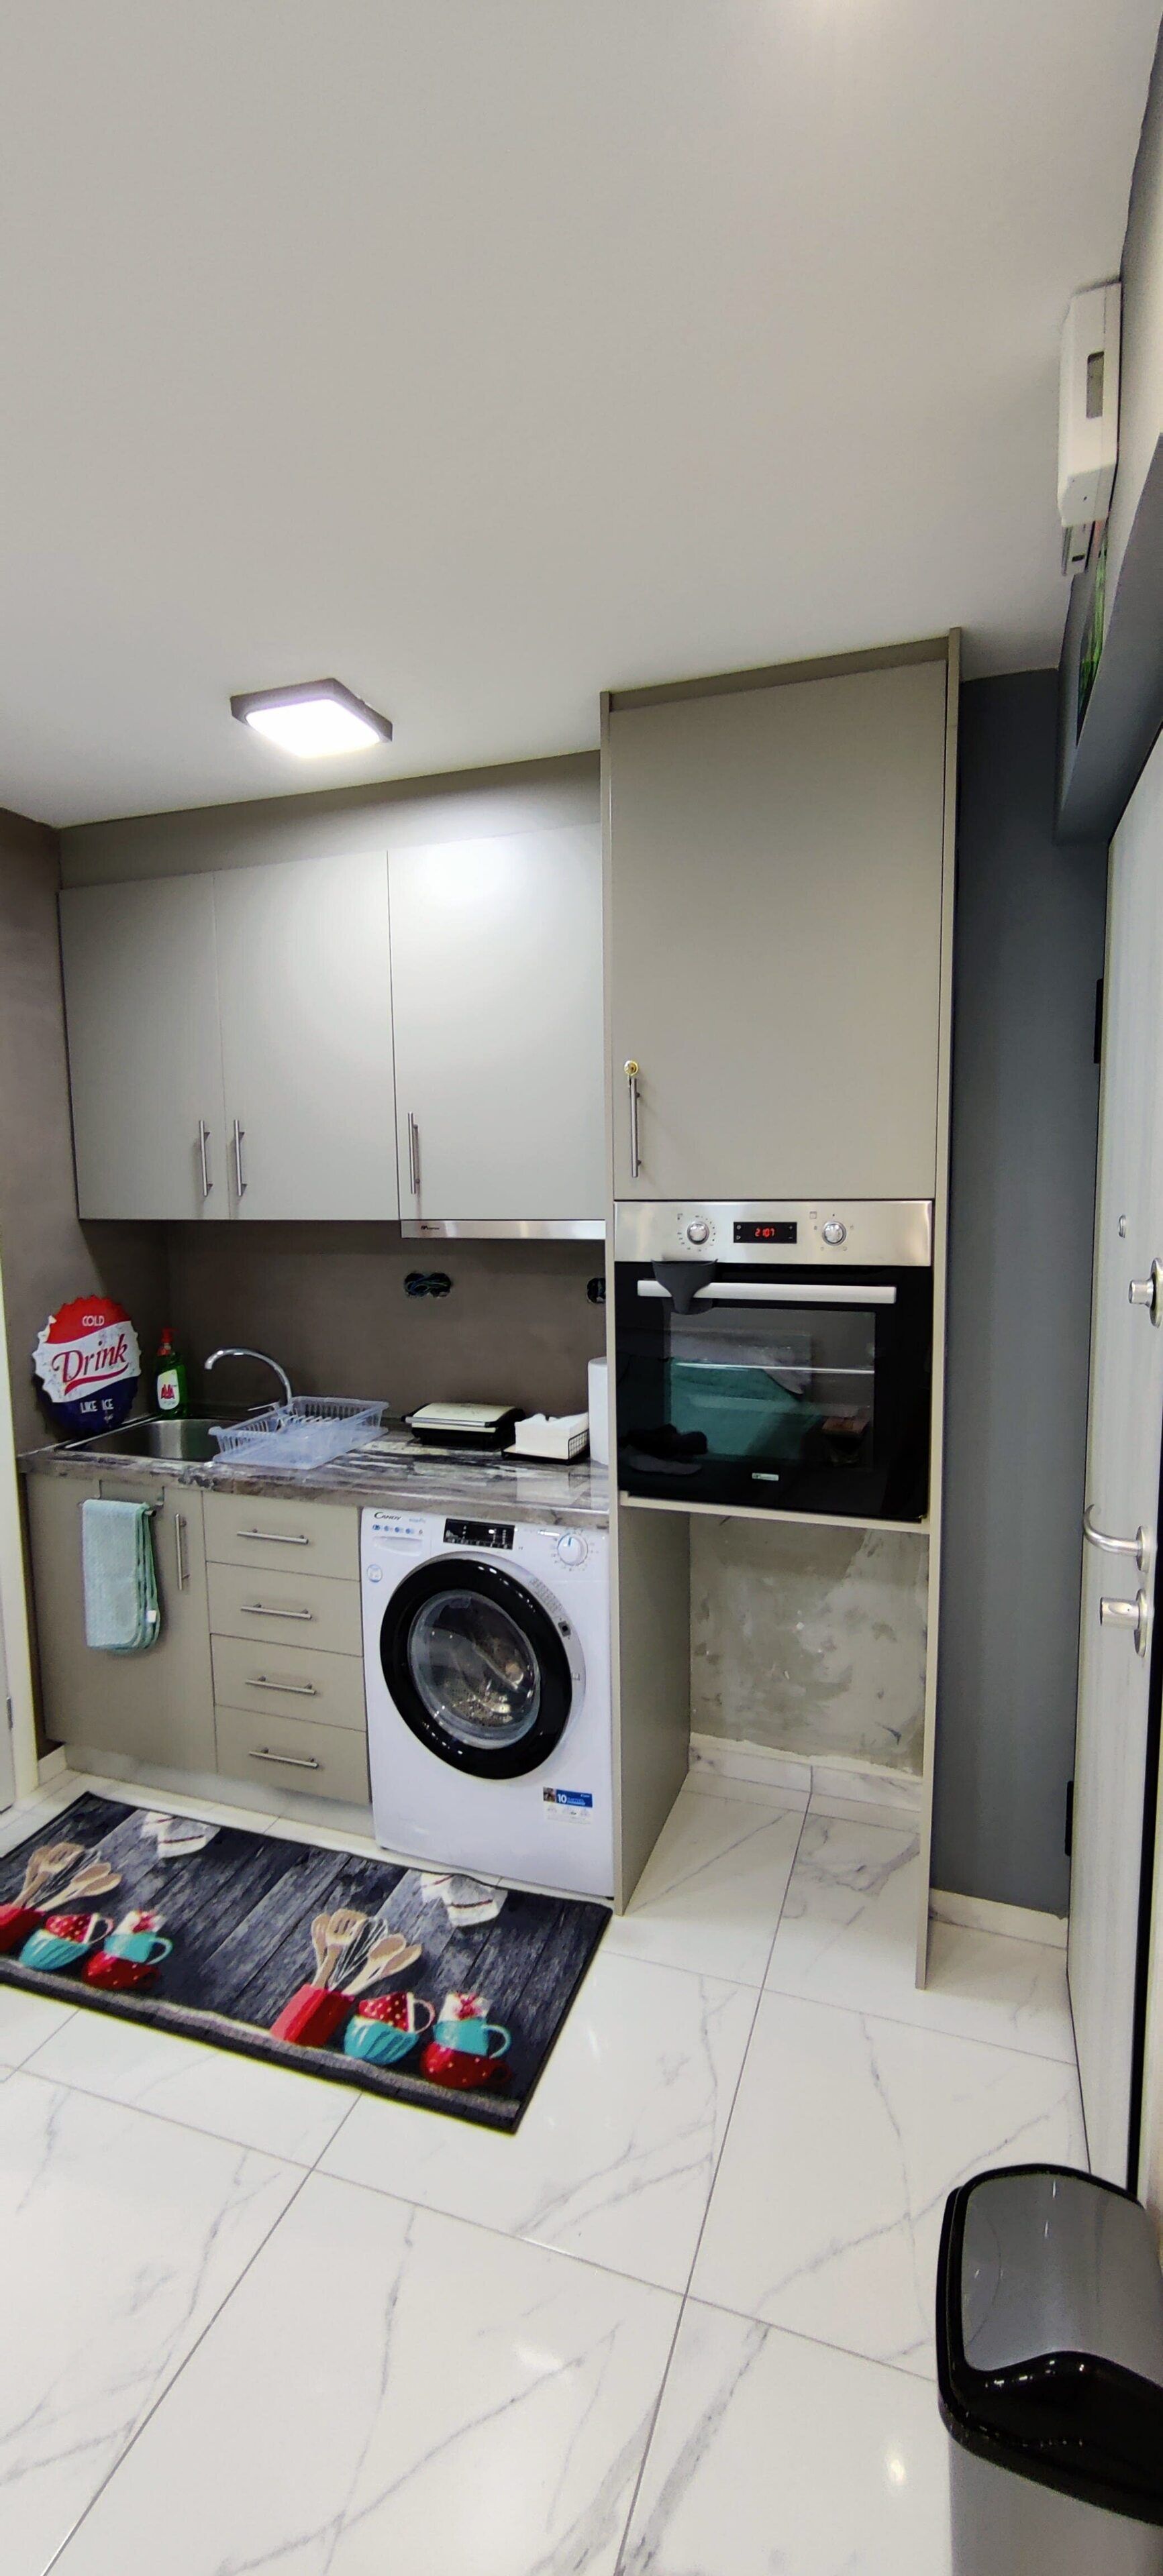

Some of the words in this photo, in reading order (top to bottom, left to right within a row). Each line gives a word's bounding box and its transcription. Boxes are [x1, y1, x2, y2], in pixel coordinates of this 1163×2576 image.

[82, 1316, 105, 1326] COLD
[52, 1333, 128, 1383] Drink
[80, 1400, 98, 1413] LIKE
[101, 1399, 114, 1410] ICE
[557, 1793, 567, 1804] 10
